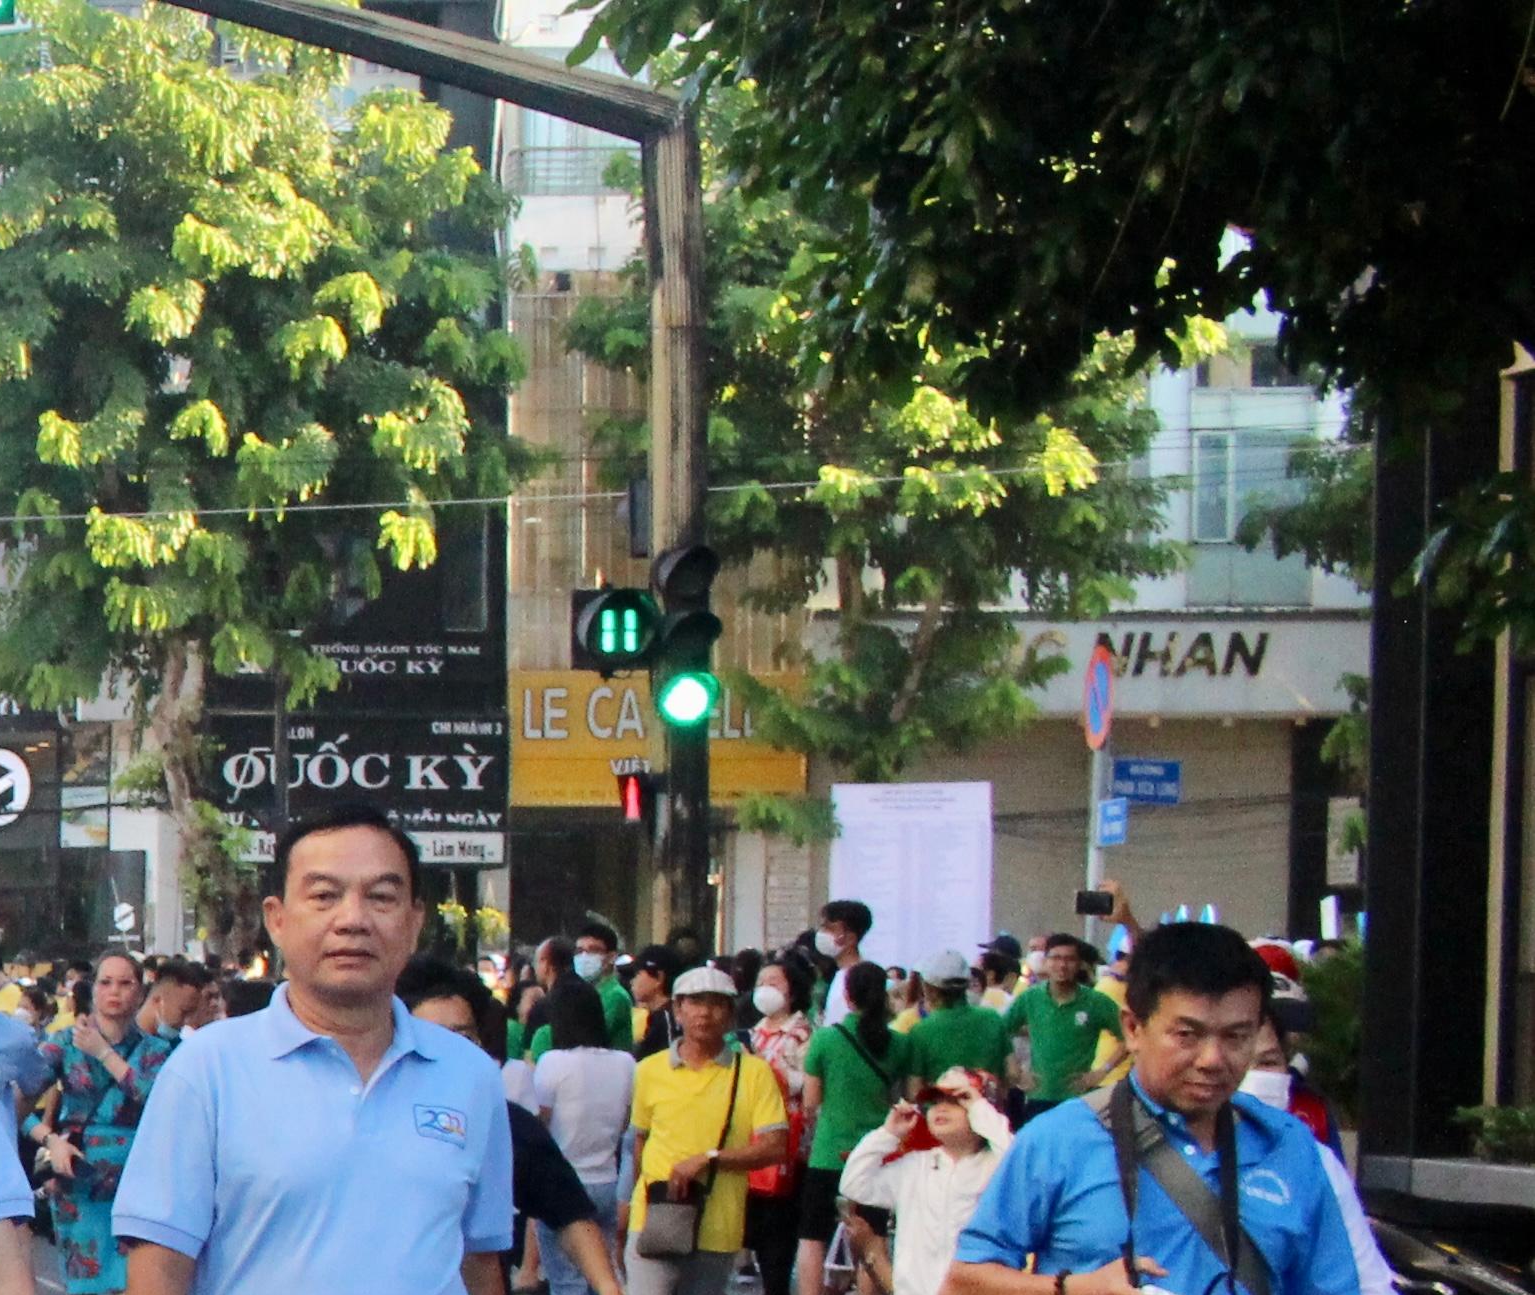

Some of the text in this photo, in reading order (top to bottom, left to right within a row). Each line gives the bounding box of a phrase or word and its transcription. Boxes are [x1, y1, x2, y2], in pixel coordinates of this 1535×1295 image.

[337, 653, 396, 675] UỐC
[495, 723, 503, 736] 3
[522, 687, 569, 740] LE
[404, 742, 494, 790] KỲ
